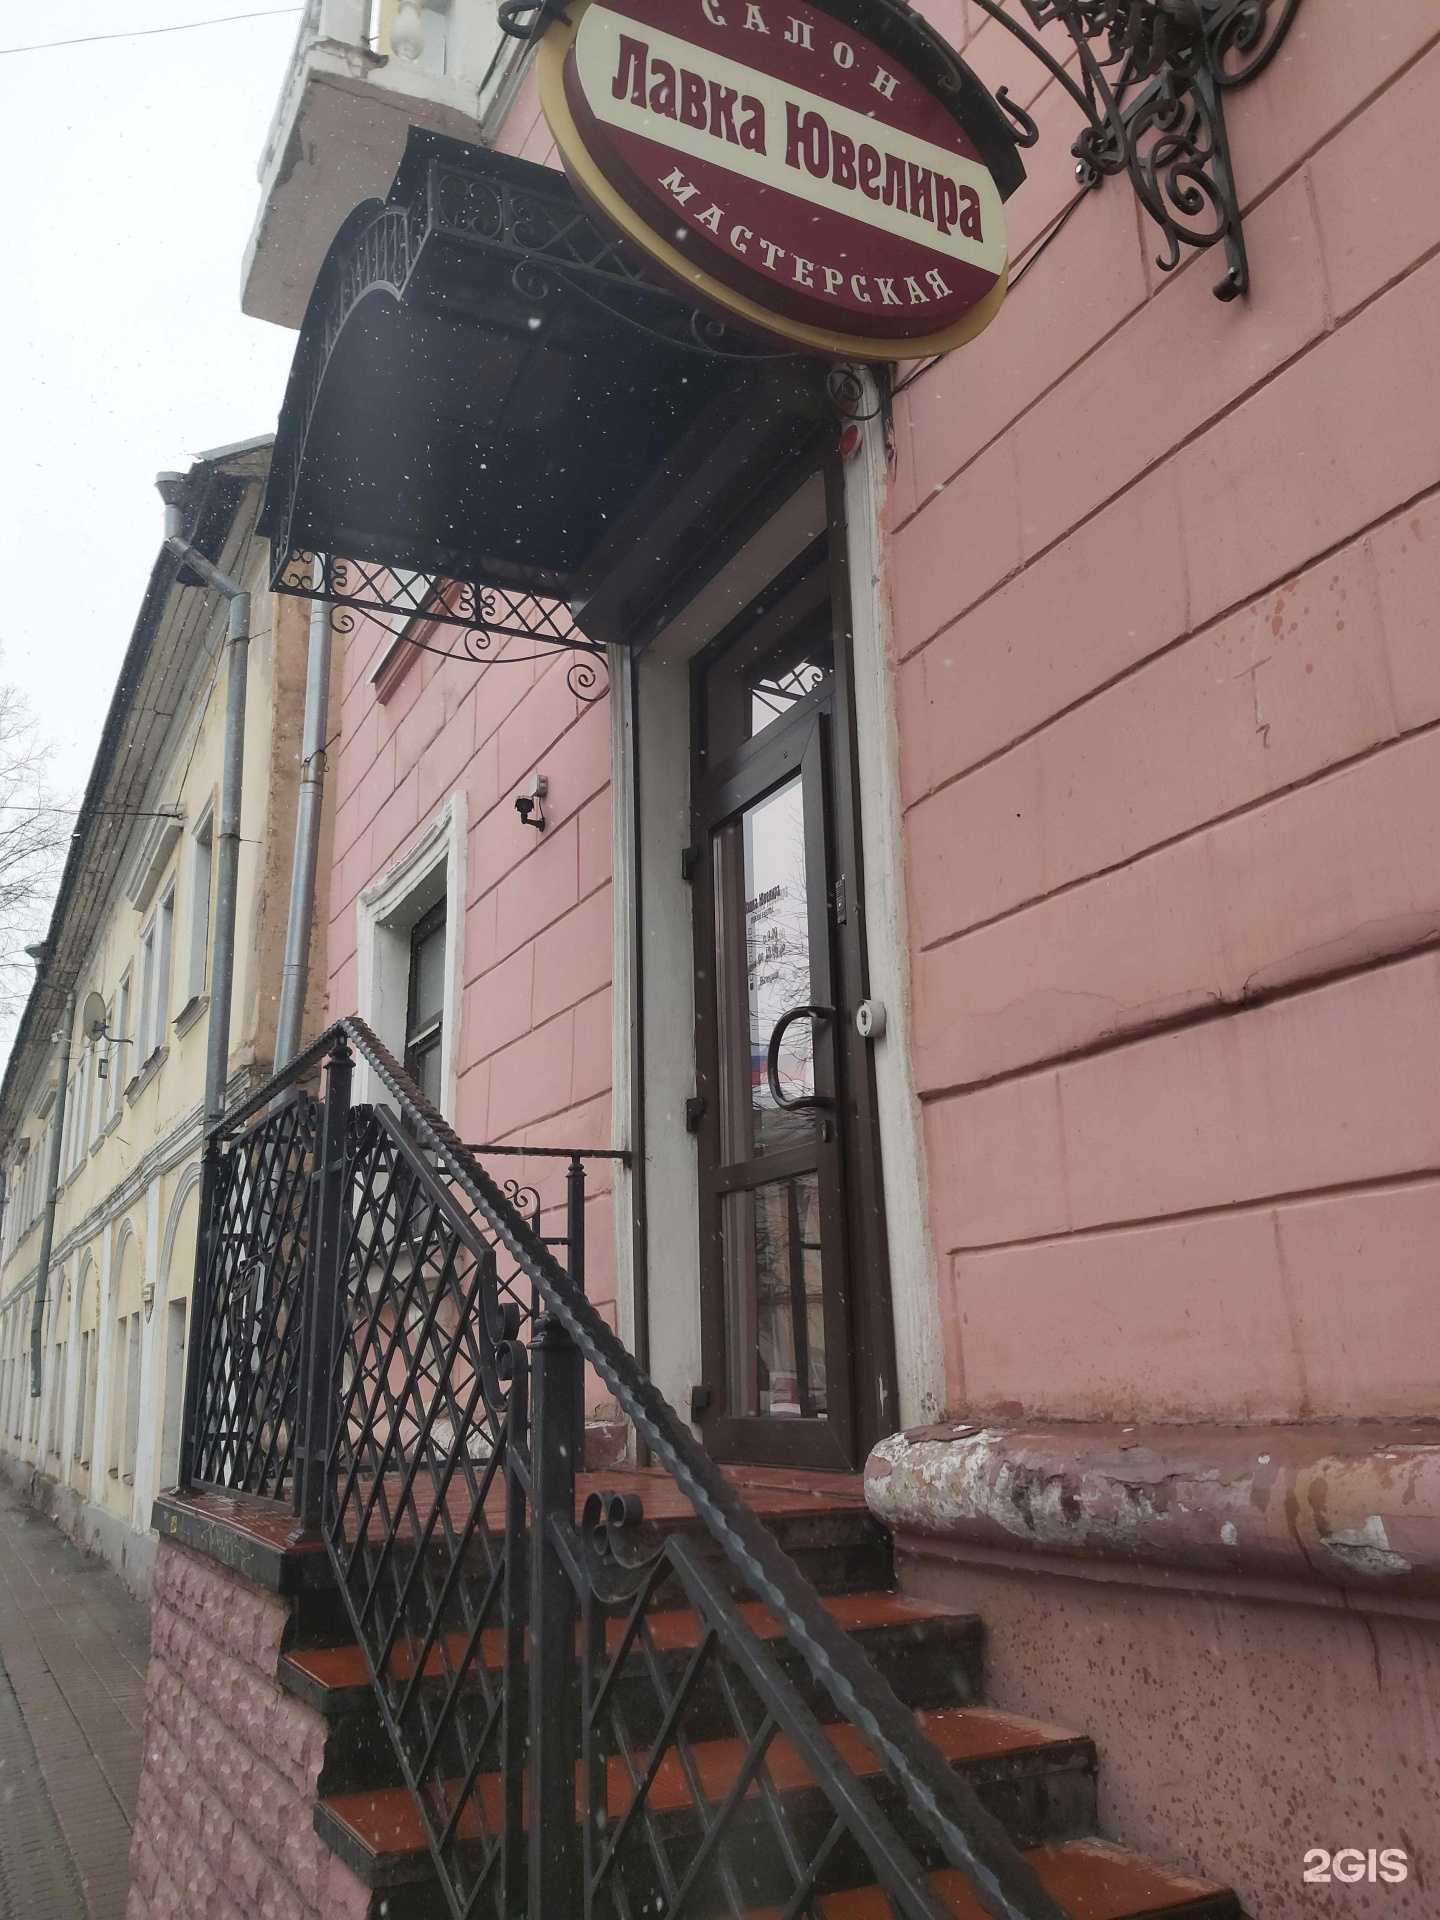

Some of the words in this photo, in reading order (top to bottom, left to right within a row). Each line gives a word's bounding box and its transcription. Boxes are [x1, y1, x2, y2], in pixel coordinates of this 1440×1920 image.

[702, 0, 901, 101] САЛОН
[611, 33, 767, 157] Лавка
[785, 101, 984, 244] Ювелира
[657, 166, 954, 305] МАСТЕРСКАЯ
